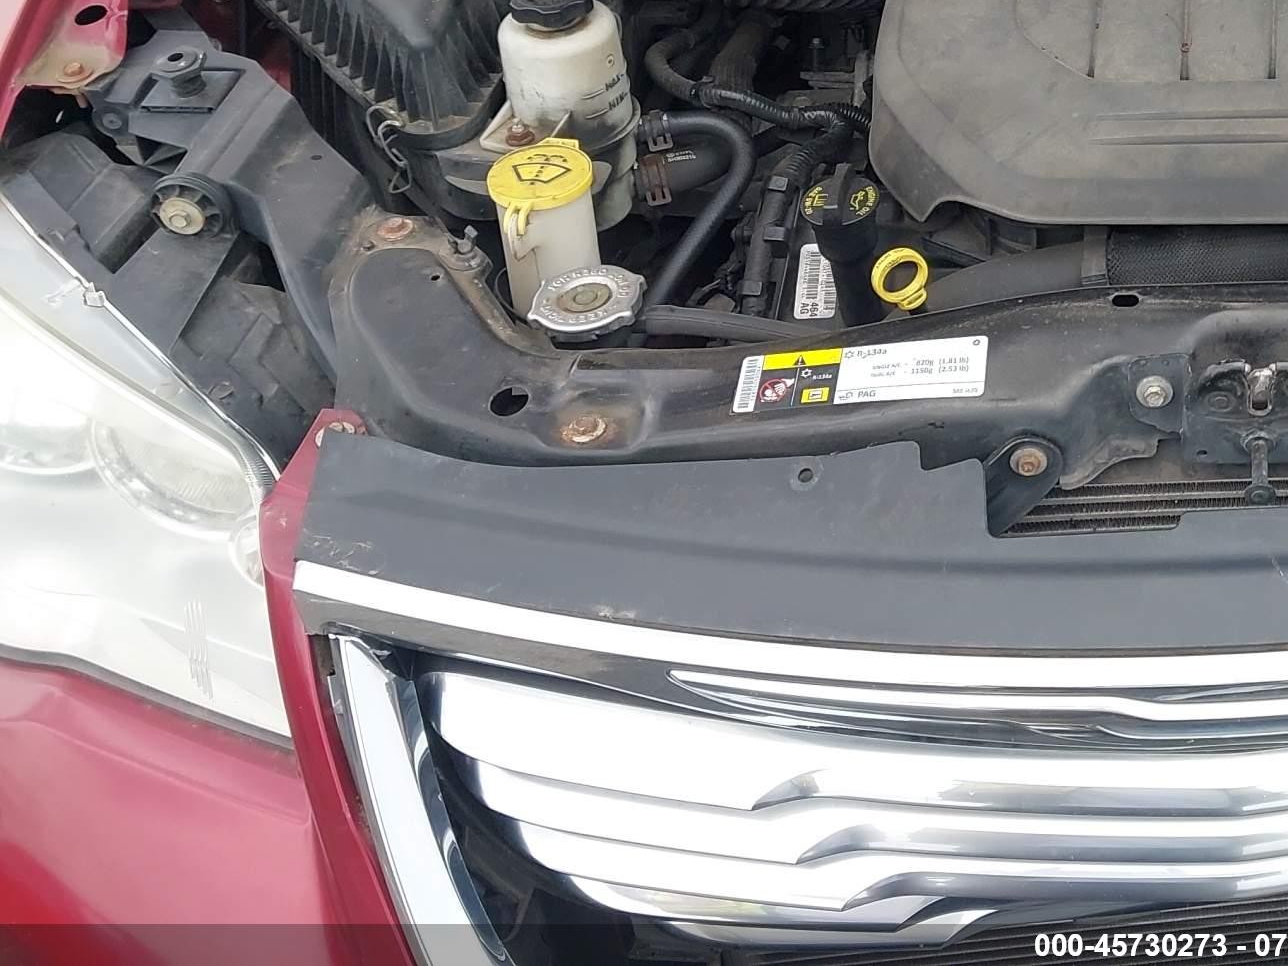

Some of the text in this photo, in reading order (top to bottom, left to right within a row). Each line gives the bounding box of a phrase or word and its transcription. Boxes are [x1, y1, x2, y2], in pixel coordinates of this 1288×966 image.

[856, 206, 870, 215] OIL
[800, 302, 809, 315] AG
[858, 390, 876, 398] PAG
